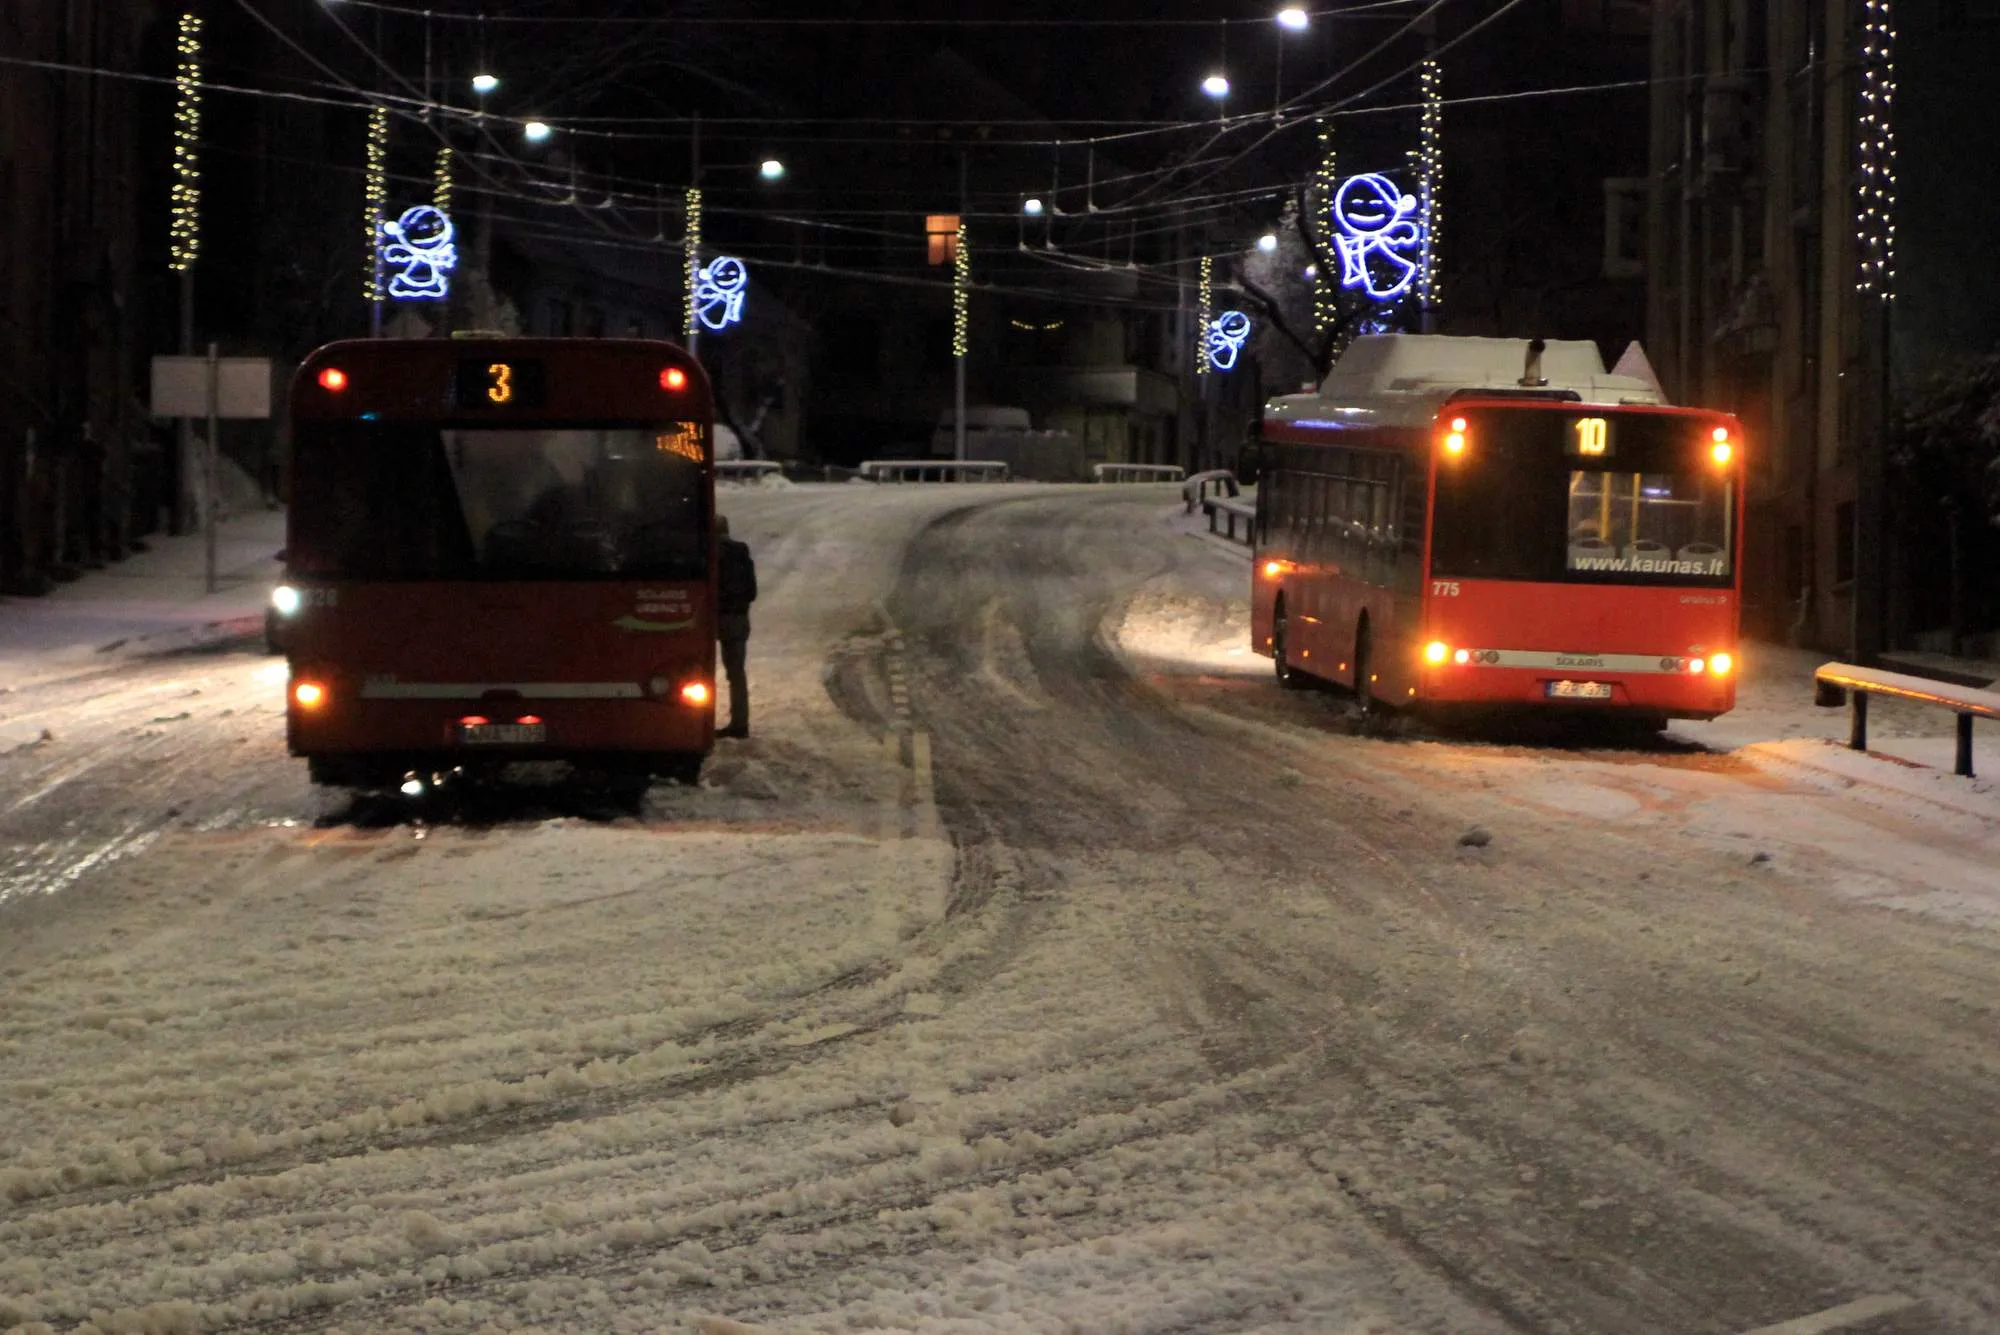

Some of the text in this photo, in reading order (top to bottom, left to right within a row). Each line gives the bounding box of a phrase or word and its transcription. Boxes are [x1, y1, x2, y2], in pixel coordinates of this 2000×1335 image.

[489, 363, 511, 402] 3
[1575, 417, 1607, 455] 10
[1575, 555, 1724, 575] www.kaunas.lt
[1432, 581, 1460, 597] 775
[1556, 656, 1604, 667] SOLARIS
